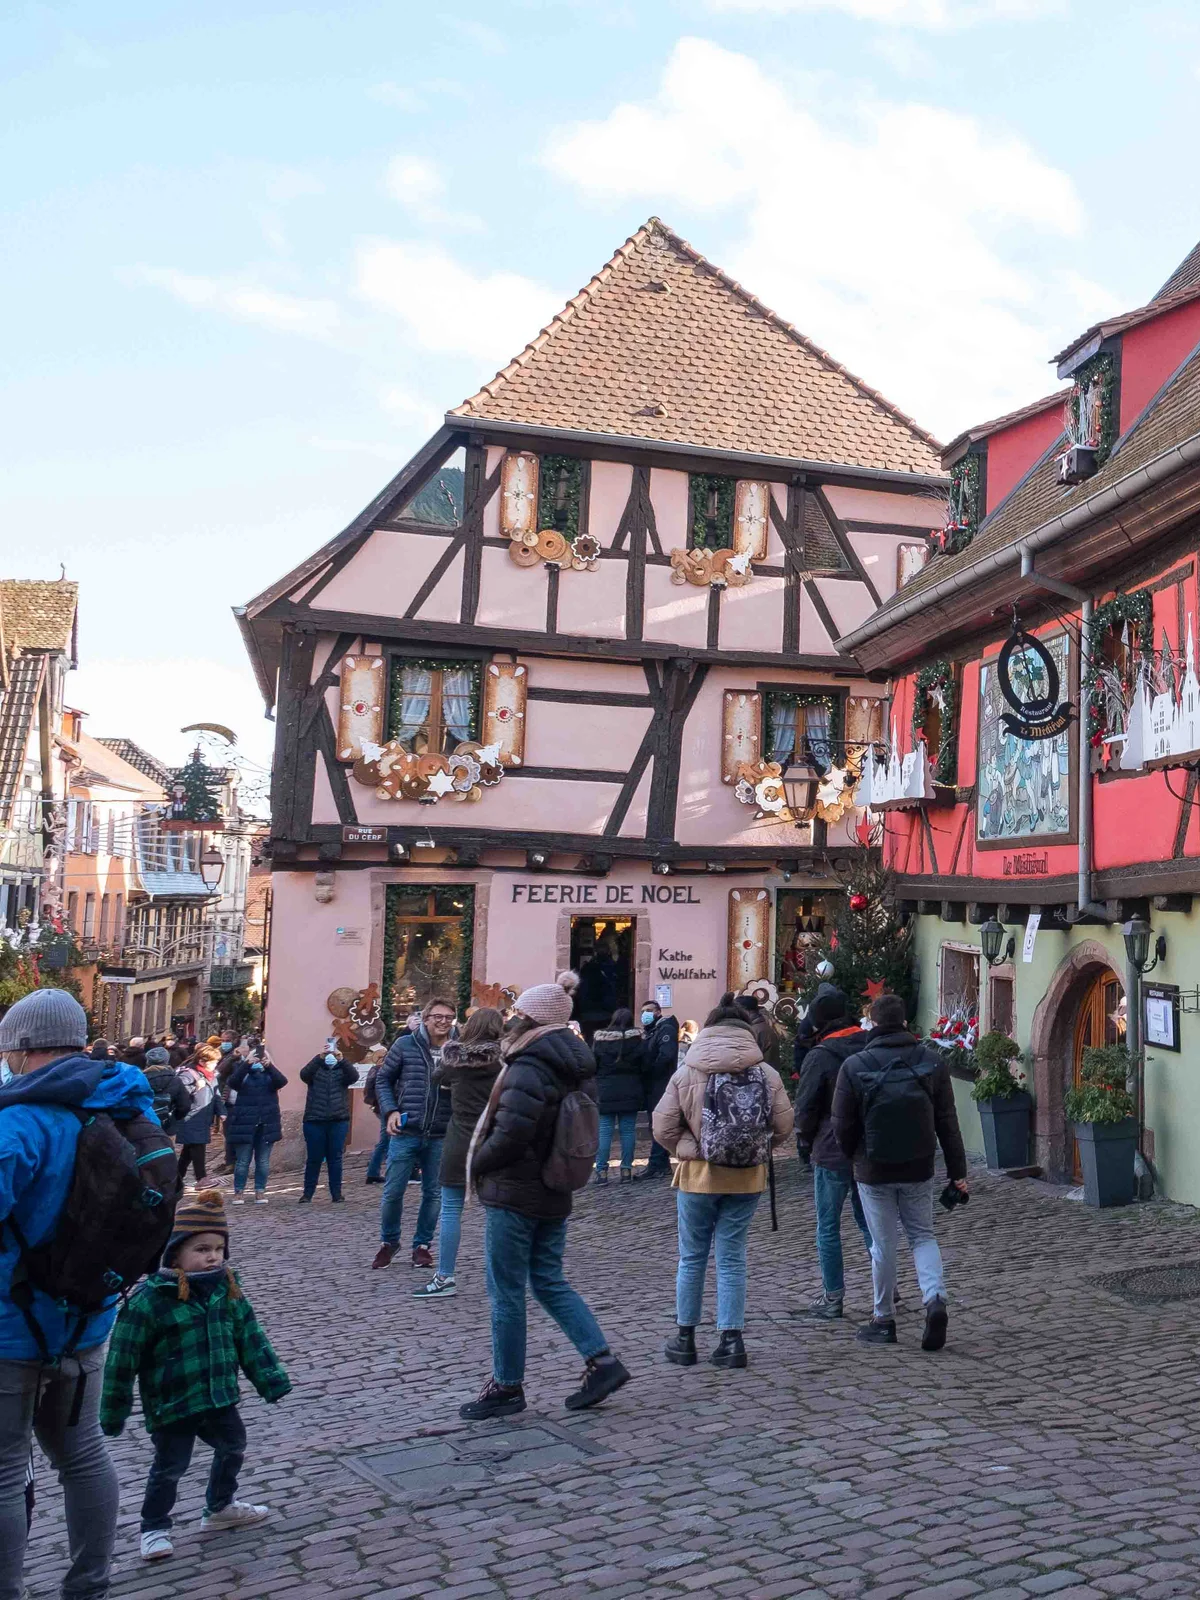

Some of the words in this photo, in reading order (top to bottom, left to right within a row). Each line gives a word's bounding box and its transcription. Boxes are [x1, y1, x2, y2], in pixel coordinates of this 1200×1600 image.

[1020, 702, 1053, 716] Restaurant
[1029, 715, 1066, 737] Médiéval
[511, 884, 598, 904] FEERIE
[605, 885, 634, 904] DE
[641, 885, 701, 904] NOEL
[658, 948, 693, 962] Kathe
[658, 967, 717, 981] Wohlfahrt
